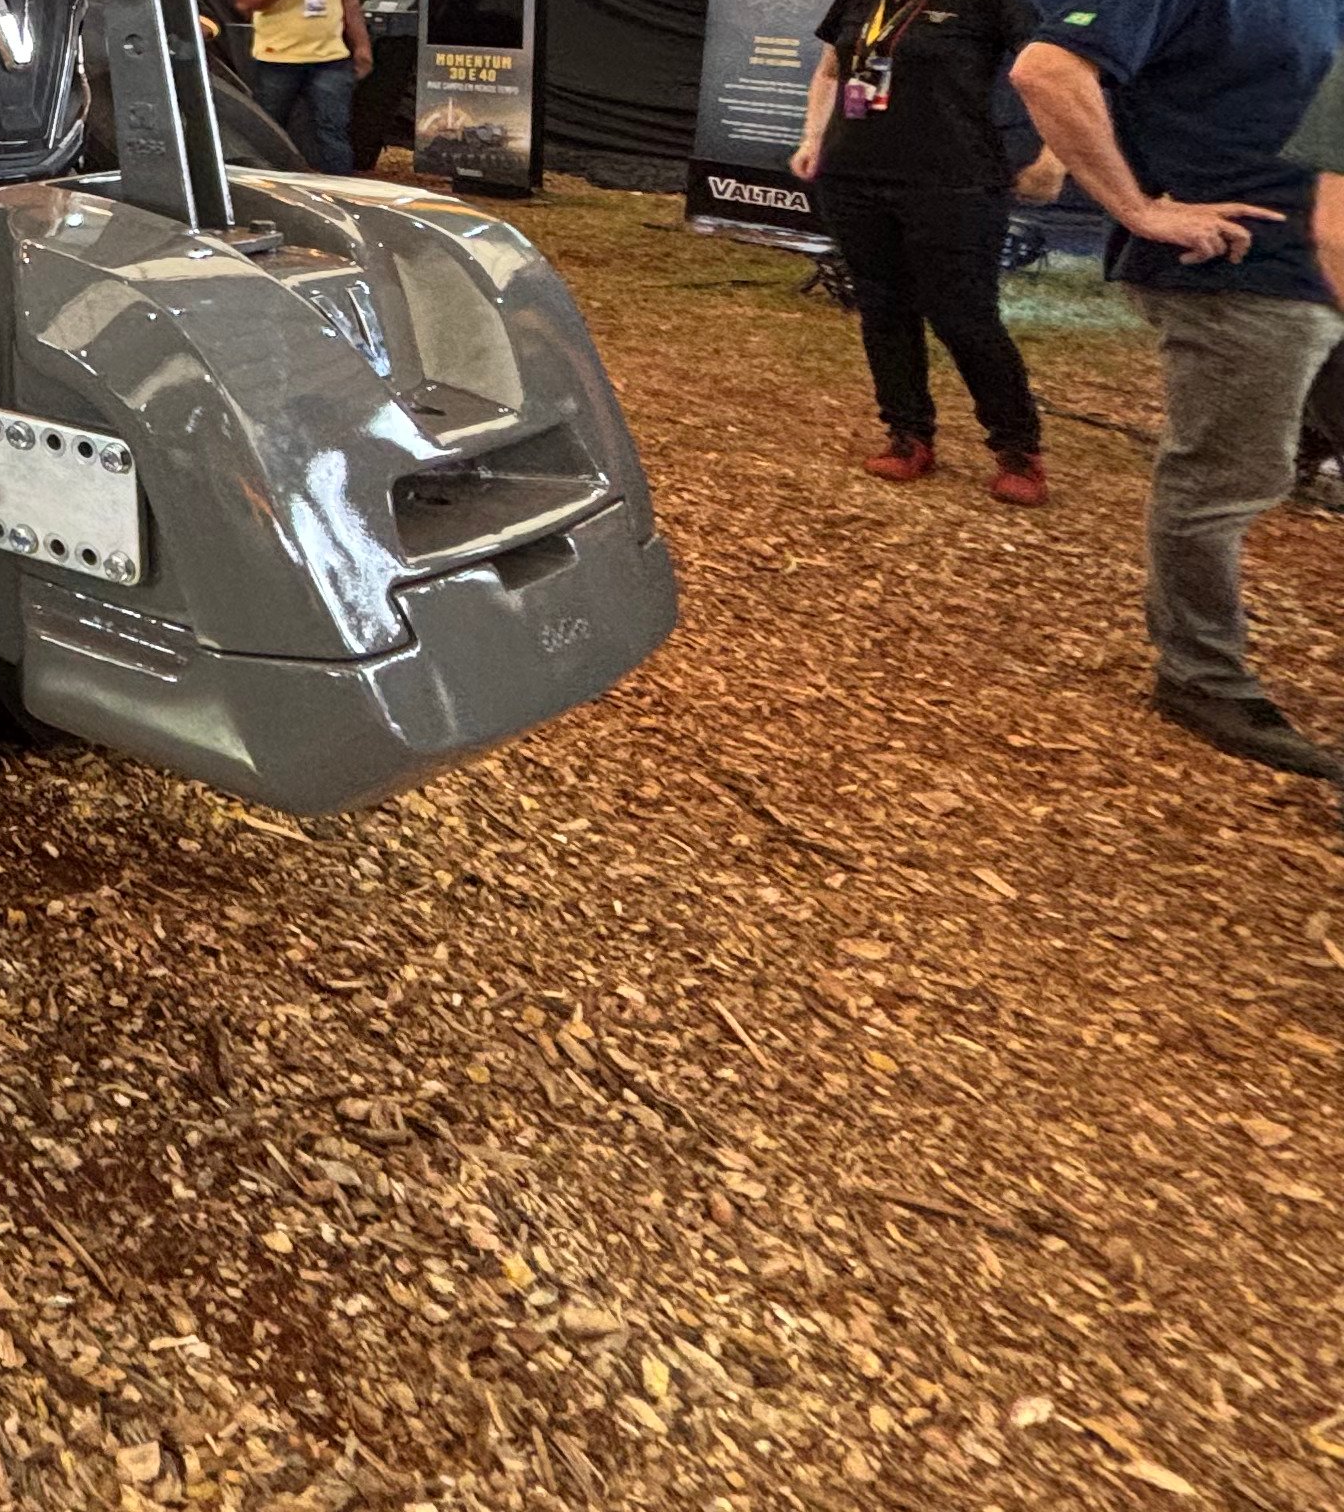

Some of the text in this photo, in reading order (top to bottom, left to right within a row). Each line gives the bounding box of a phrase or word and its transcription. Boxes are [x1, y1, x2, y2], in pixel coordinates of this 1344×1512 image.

[435, 52, 513, 70] MOMENTUM
[468, 69, 477, 81] E
[478, 69, 497, 82] 40
[707, 176, 811, 214] VALTRA
